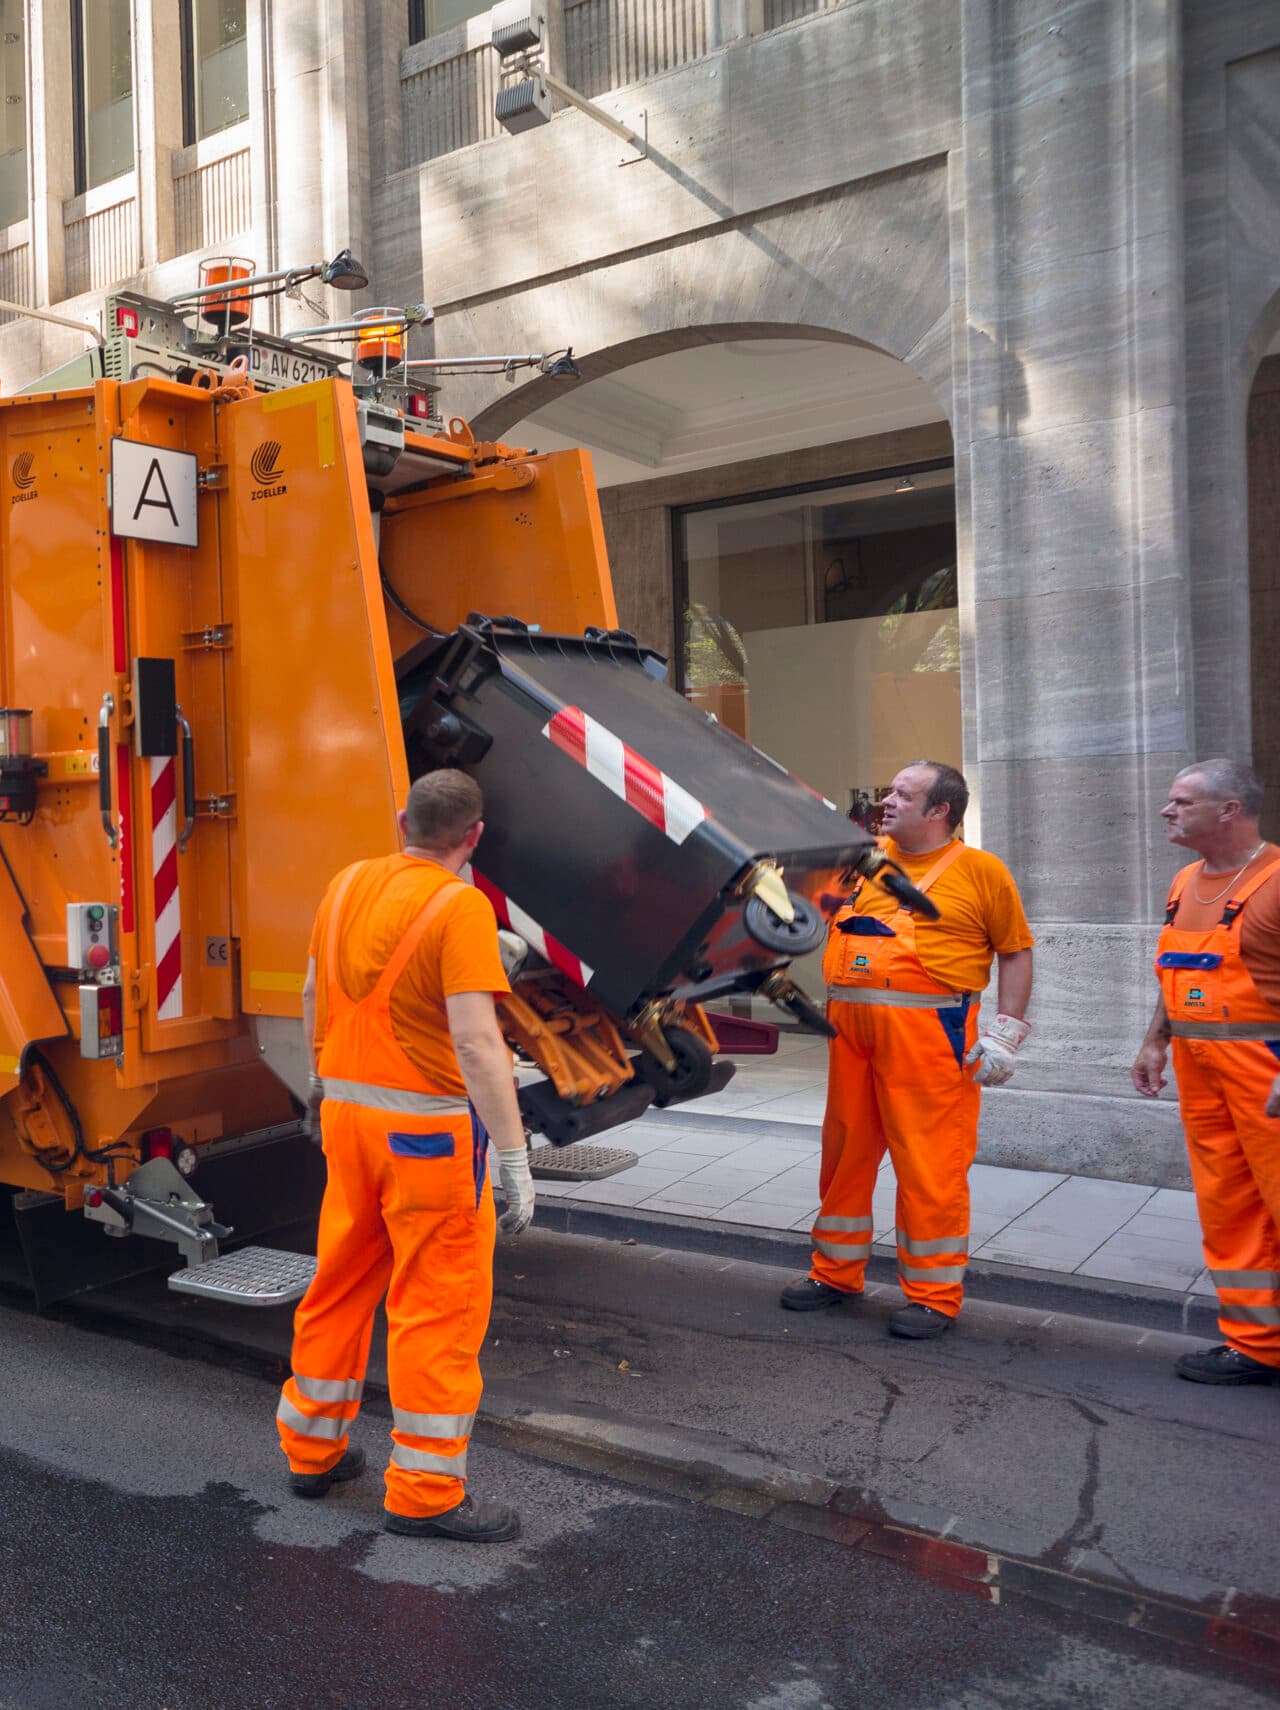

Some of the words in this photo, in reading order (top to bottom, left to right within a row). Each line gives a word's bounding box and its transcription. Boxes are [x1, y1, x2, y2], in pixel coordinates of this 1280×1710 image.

[252, 348, 260, 370] D
[271, 354, 289, 378] AW
[292, 361, 326, 383] 6217
[11, 490, 38, 504] ZOELLER
[133, 458, 179, 527] A
[251, 486, 287, 501] ZOELLER
